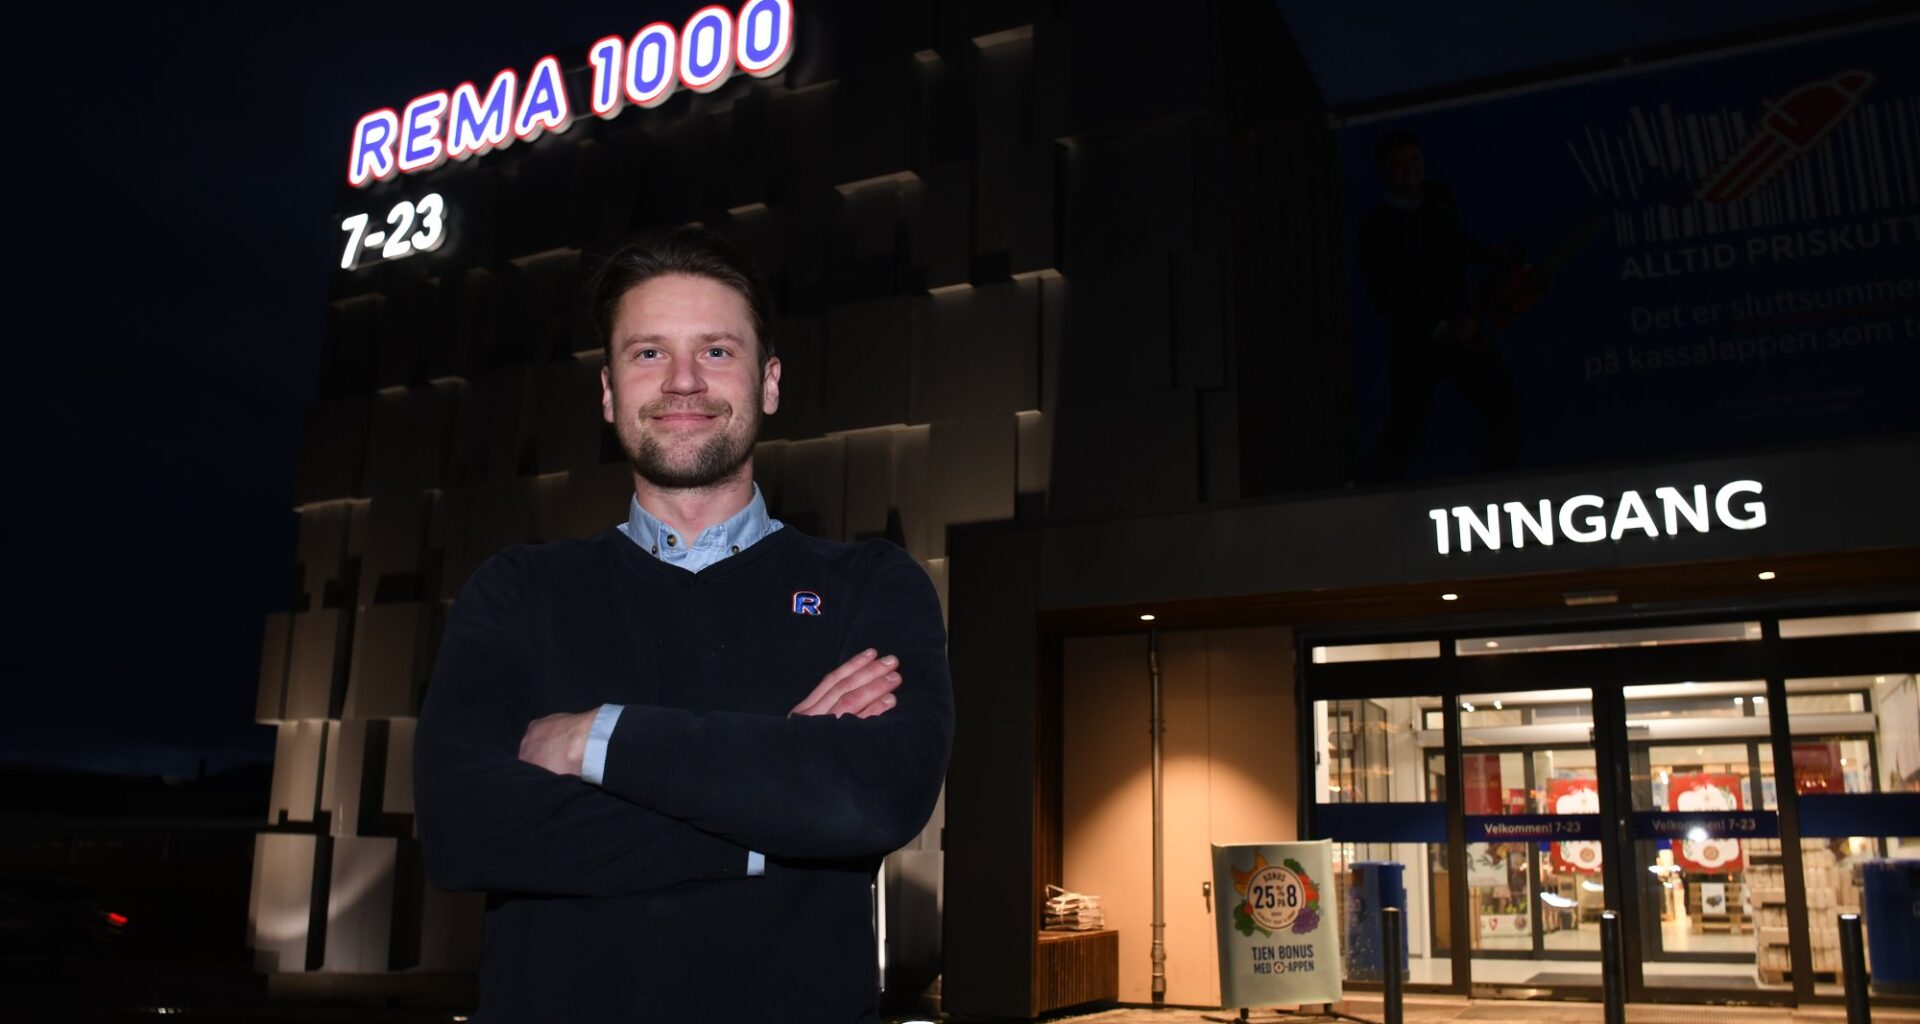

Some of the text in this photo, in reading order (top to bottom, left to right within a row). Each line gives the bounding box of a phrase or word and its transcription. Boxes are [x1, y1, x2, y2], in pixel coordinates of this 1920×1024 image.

[348, 0, 795, 188] REMA 1000
[340, 192, 446, 270] 7-23
[1621, 242, 1736, 282] ALLTID
[1631, 278, 1920, 332] Det er sluttsumme
[1585, 315, 1920, 380] på kassalappen som t
[1429, 479, 1767, 555] INNGANG
[792, 590, 822, 616] R
[1484, 821, 1581, 835] Velkommen! 7-23
[1728, 817, 1757, 832] 7-23
[1253, 885, 1275, 909] 25
[1286, 884, 1297, 908] 8
[1251, 944, 1314, 961] TJEN BONUS
[1253, 962, 1272, 975] MED
